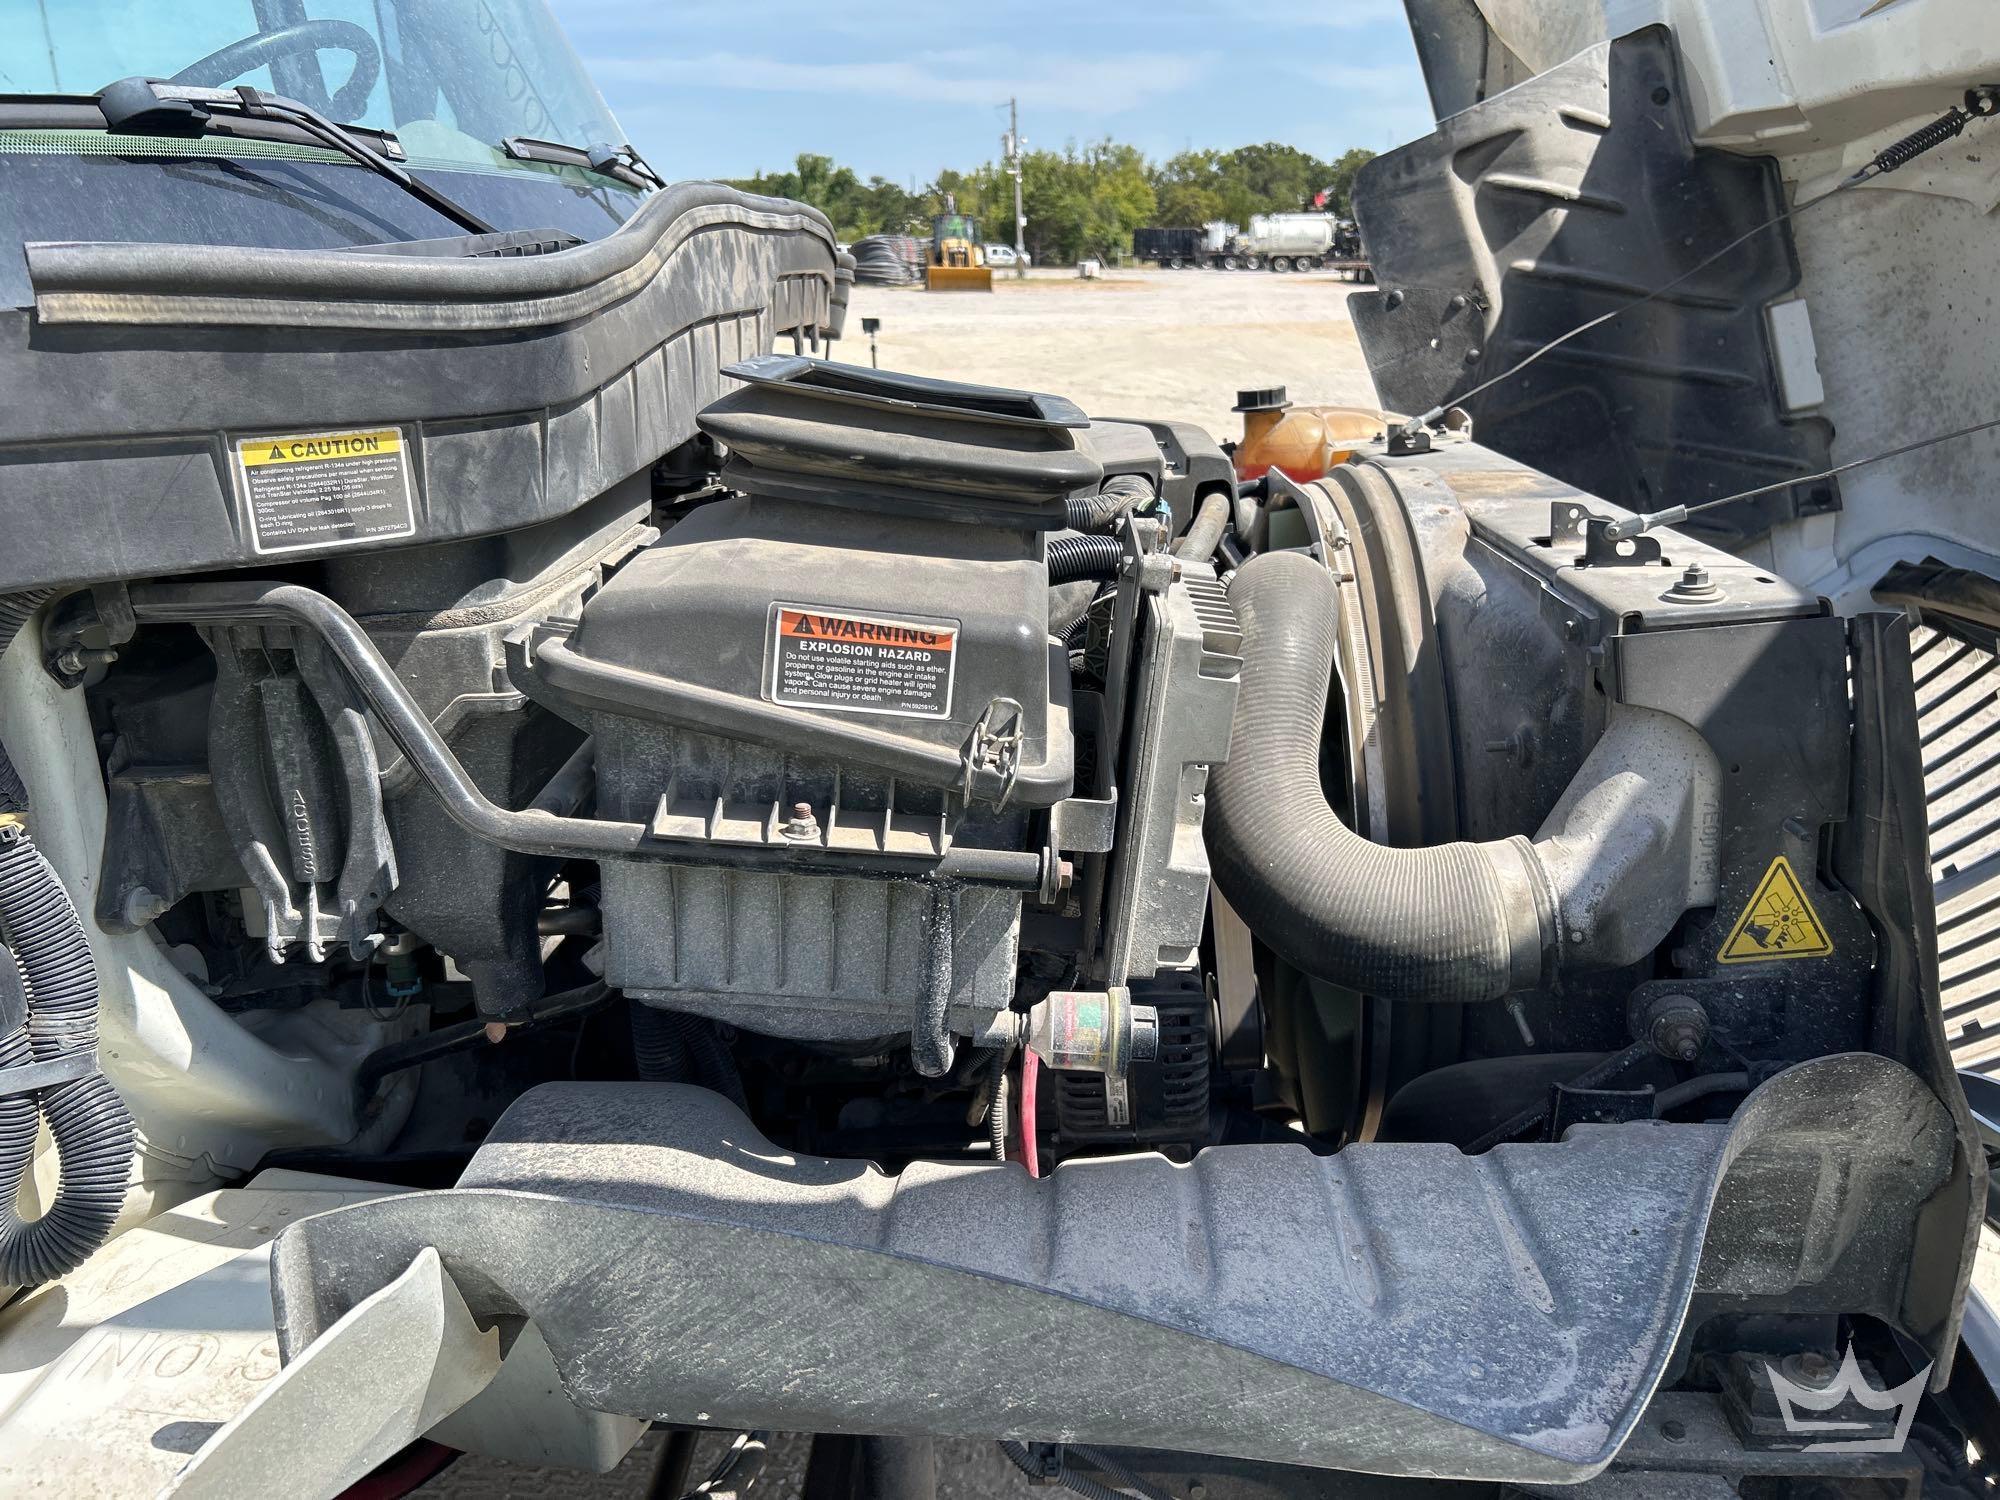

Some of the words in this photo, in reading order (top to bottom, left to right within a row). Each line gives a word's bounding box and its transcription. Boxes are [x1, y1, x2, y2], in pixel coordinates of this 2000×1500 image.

[290, 437, 380, 458] CAUTION
[259, 466, 293, 475] conditioning
[295, 472, 327, 480] precautions
[256, 498, 290, 507] Compressor
[277, 512, 306, 520] lubricating
[818, 615, 937, 645] WARNING
[799, 639, 872, 656] EXPLOSION
[878, 648, 931, 662] HAZARD
[786, 651, 796, 659] Do
[797, 652, 809, 660] not
[826, 655, 851, 664] volatile
[852, 658, 879, 667] starting
[897, 662, 914, 670] such
[785, 660, 815, 670] propane
[816, 663, 824, 671] or
[825, 664, 855, 674] gasoline
[865, 668, 876, 676] the
[878, 669, 902, 678] engine
[903, 671, 913, 679] air
[914, 672, 936, 681] intake
[814, 672, 832, 680] Glow
[834, 673, 853, 682] plugs
[864, 676, 877, 684] grid
[879, 677, 902, 686] heater
[783, 686, 797, 694] and
[798, 687, 829, 696] personal
[831, 689, 850, 698] injury
[812, 680, 826, 688] Can
[828, 681, 850, 690] cause
[852, 683, 875, 692] severe
[877, 685, 901, 694] engine
[903, 688, 931, 696] damage
[294, 789, 316, 875] ACCESS
